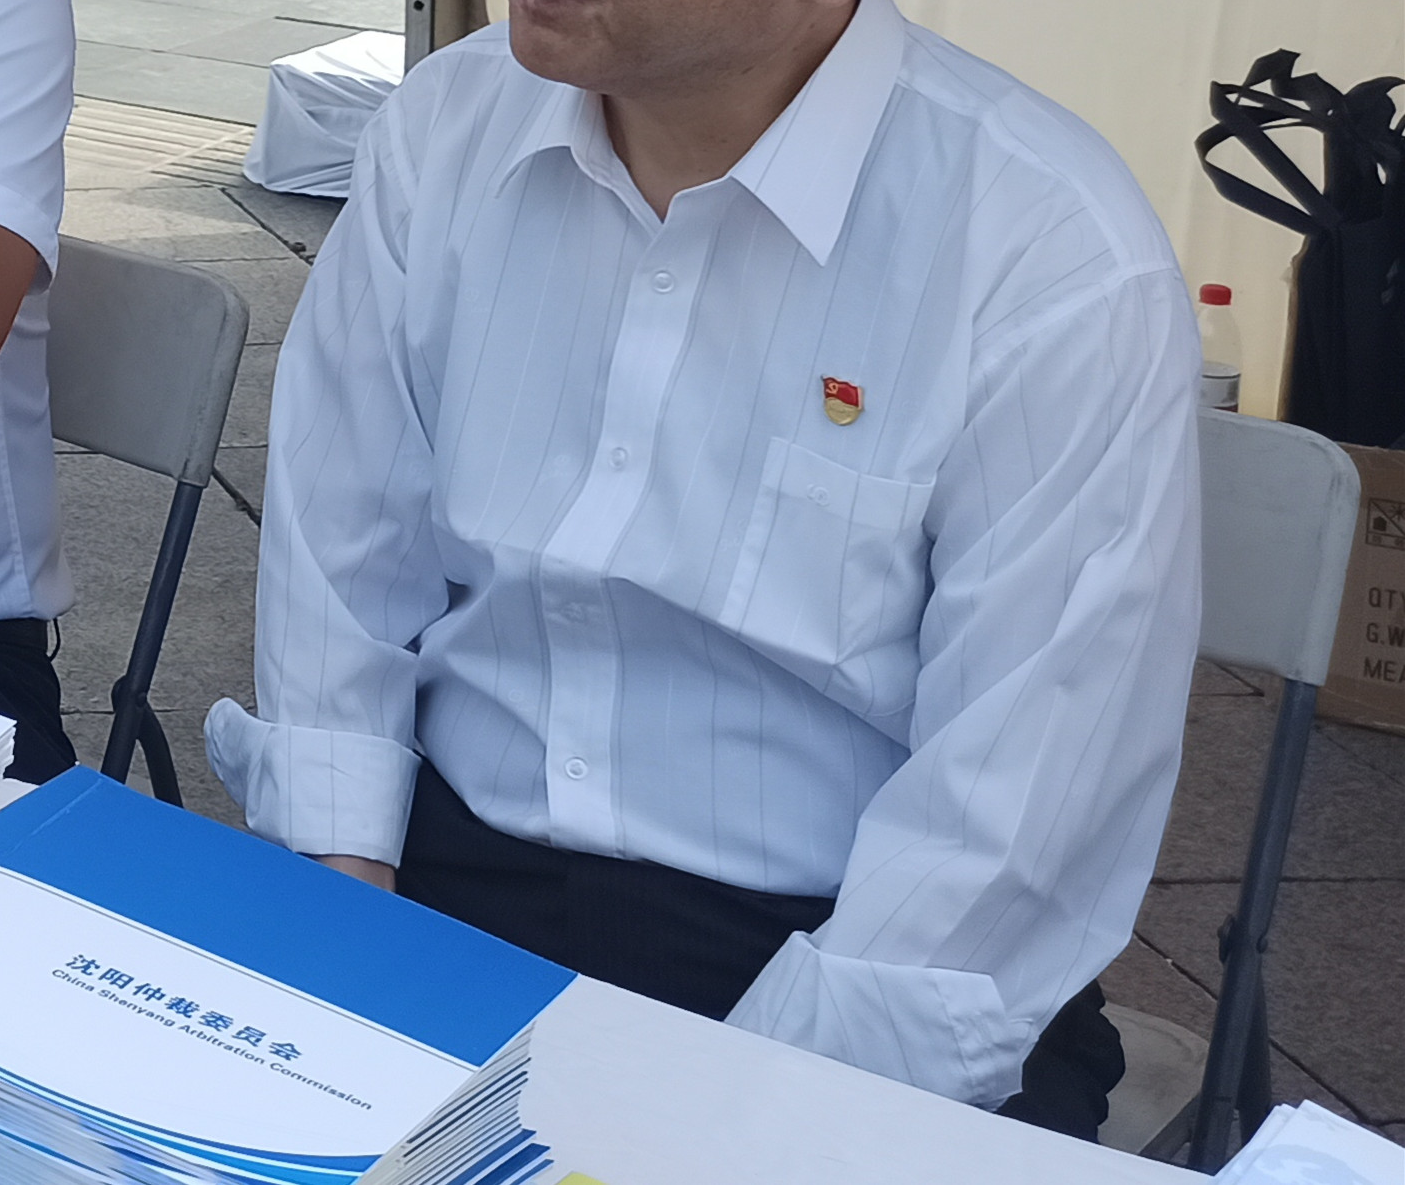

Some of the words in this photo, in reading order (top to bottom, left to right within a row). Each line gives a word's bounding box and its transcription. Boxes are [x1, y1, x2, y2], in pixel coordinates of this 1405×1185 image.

[52, 968, 95, 993] China
[97, 988, 176, 1028] Shenyang
[178, 1023, 266, 1065] Arbitration
[269, 1062, 374, 1111] Commission
[64, 953, 303, 1061] 沈阳仲裁委员会
